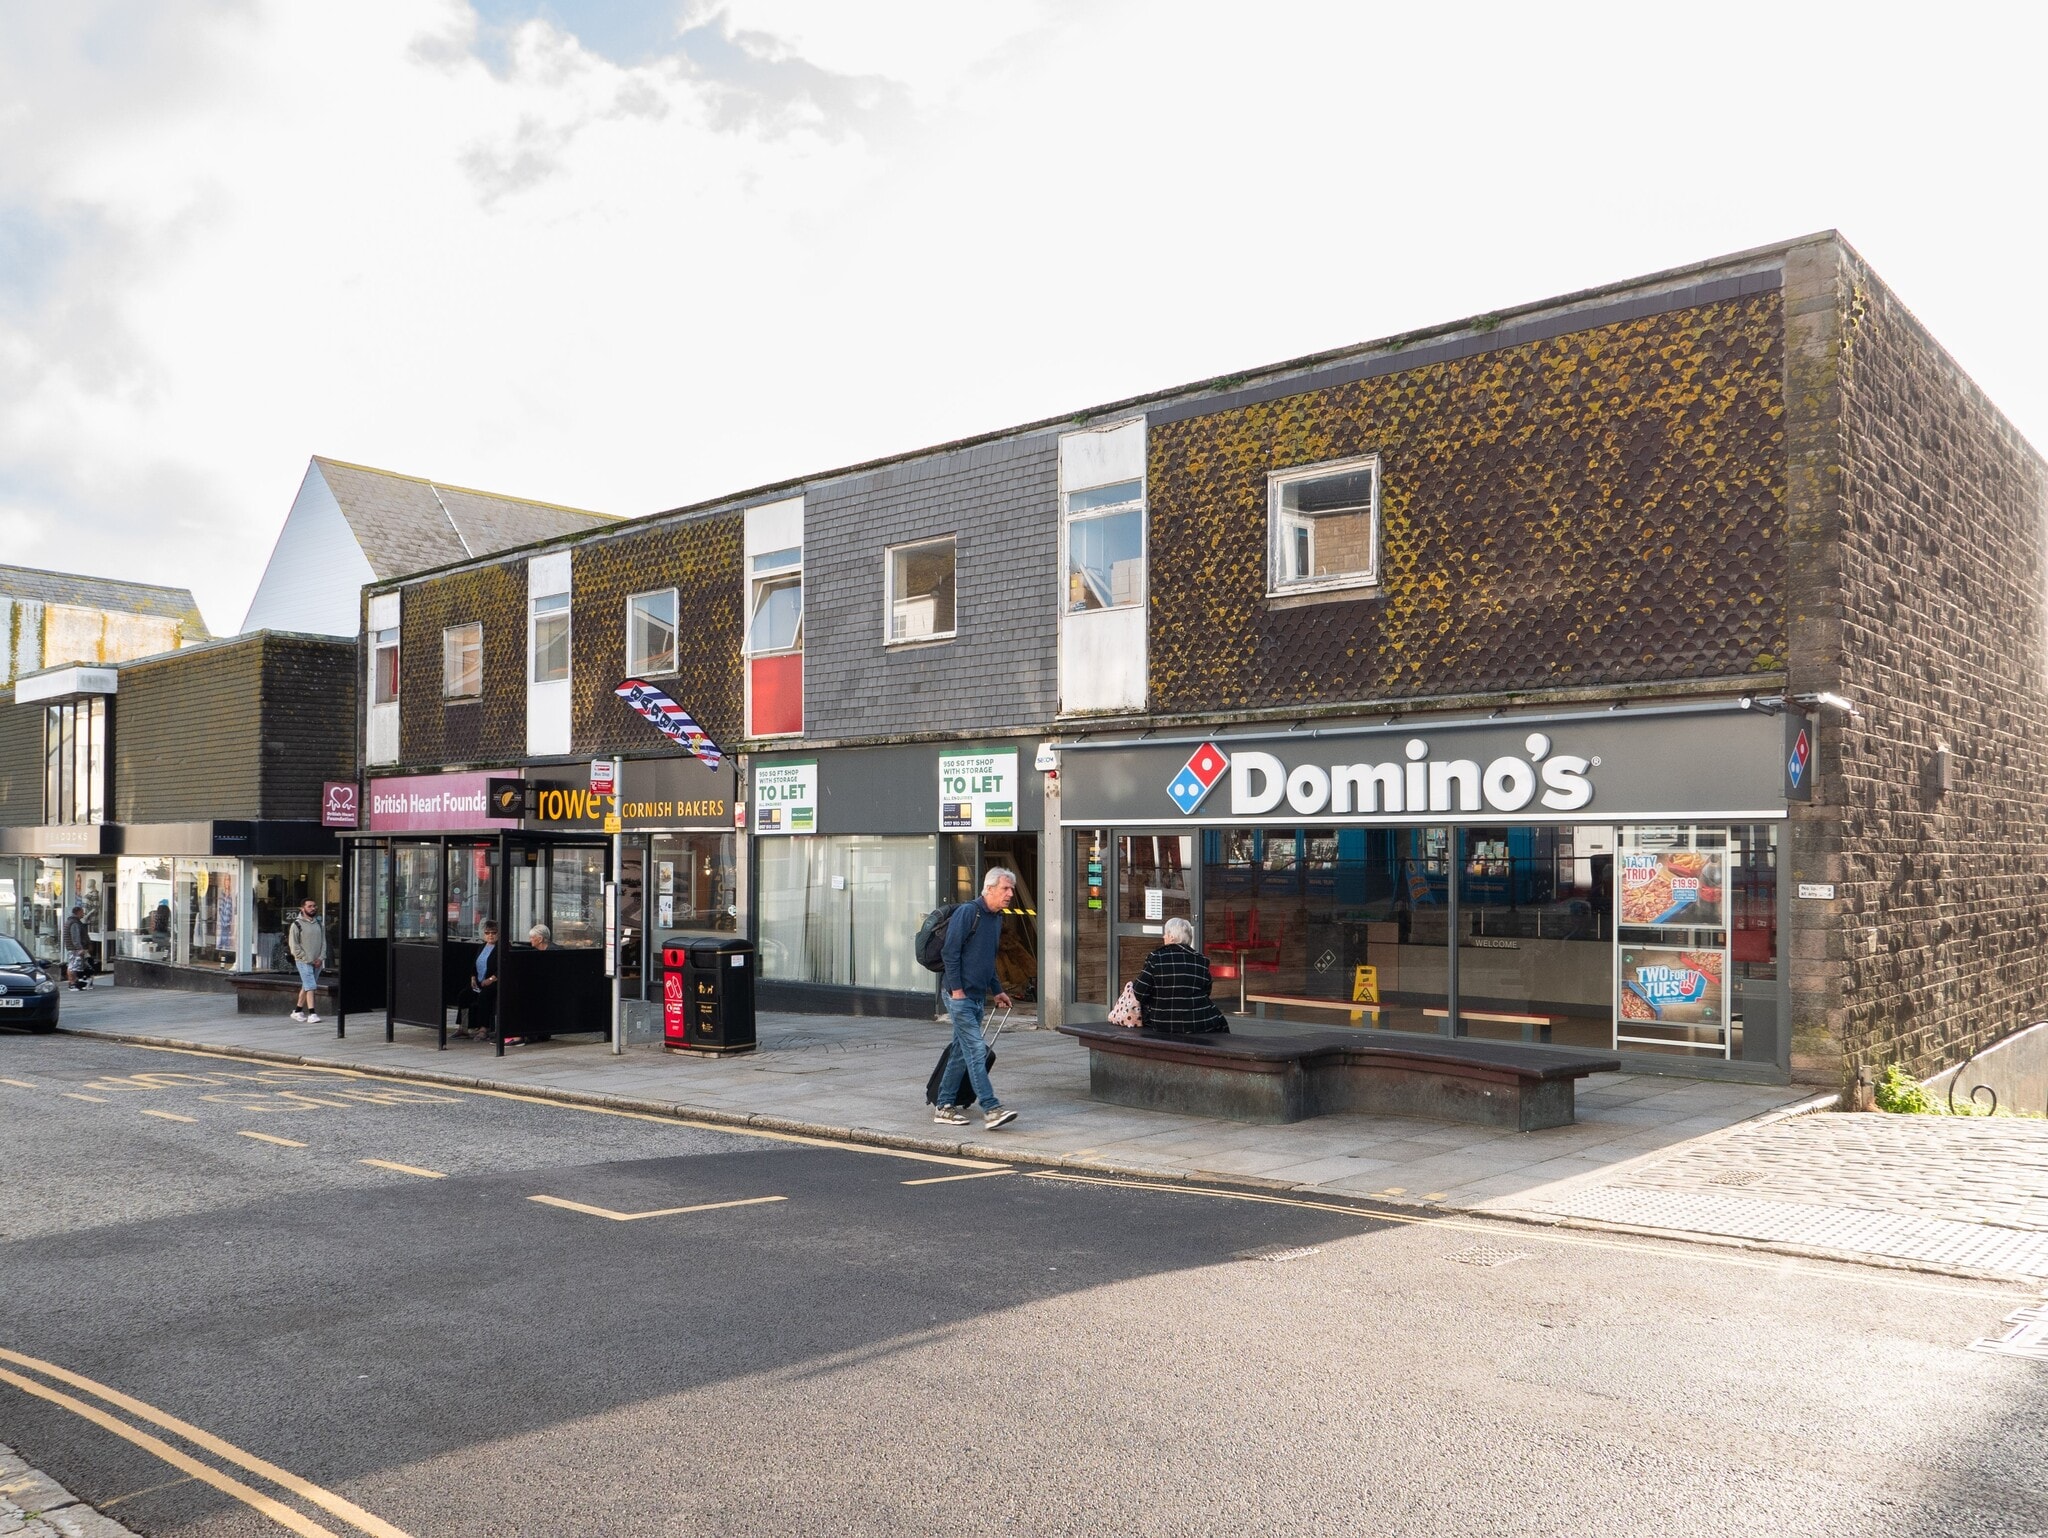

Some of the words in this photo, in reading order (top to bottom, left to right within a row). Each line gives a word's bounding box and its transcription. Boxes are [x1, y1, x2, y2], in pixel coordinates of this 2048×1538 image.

[1231, 733, 1593, 815] Domino's
[759, 785, 777, 801] TO
[781, 783, 806, 800] LET
[943, 776, 966, 794] TO
[971, 775, 1004, 793] LET
[374, 793, 408, 814] British
[410, 792, 441, 813] Heart
[443, 790, 487, 812] Founda
[622, 802, 672, 818] CORNISH
[677, 800, 724, 817] BAKERS
[1625, 856, 1656, 868] TASTY
[1626, 868, 1647, 880] TRIO
[1672, 879, 1697, 888] £19.99
[1475, 939, 1517, 948] WELCOME
[1637, 965, 1668, 983] TWO
[1669, 971, 1686, 980] FOR
[1646, 981, 1680, 997] TUES
